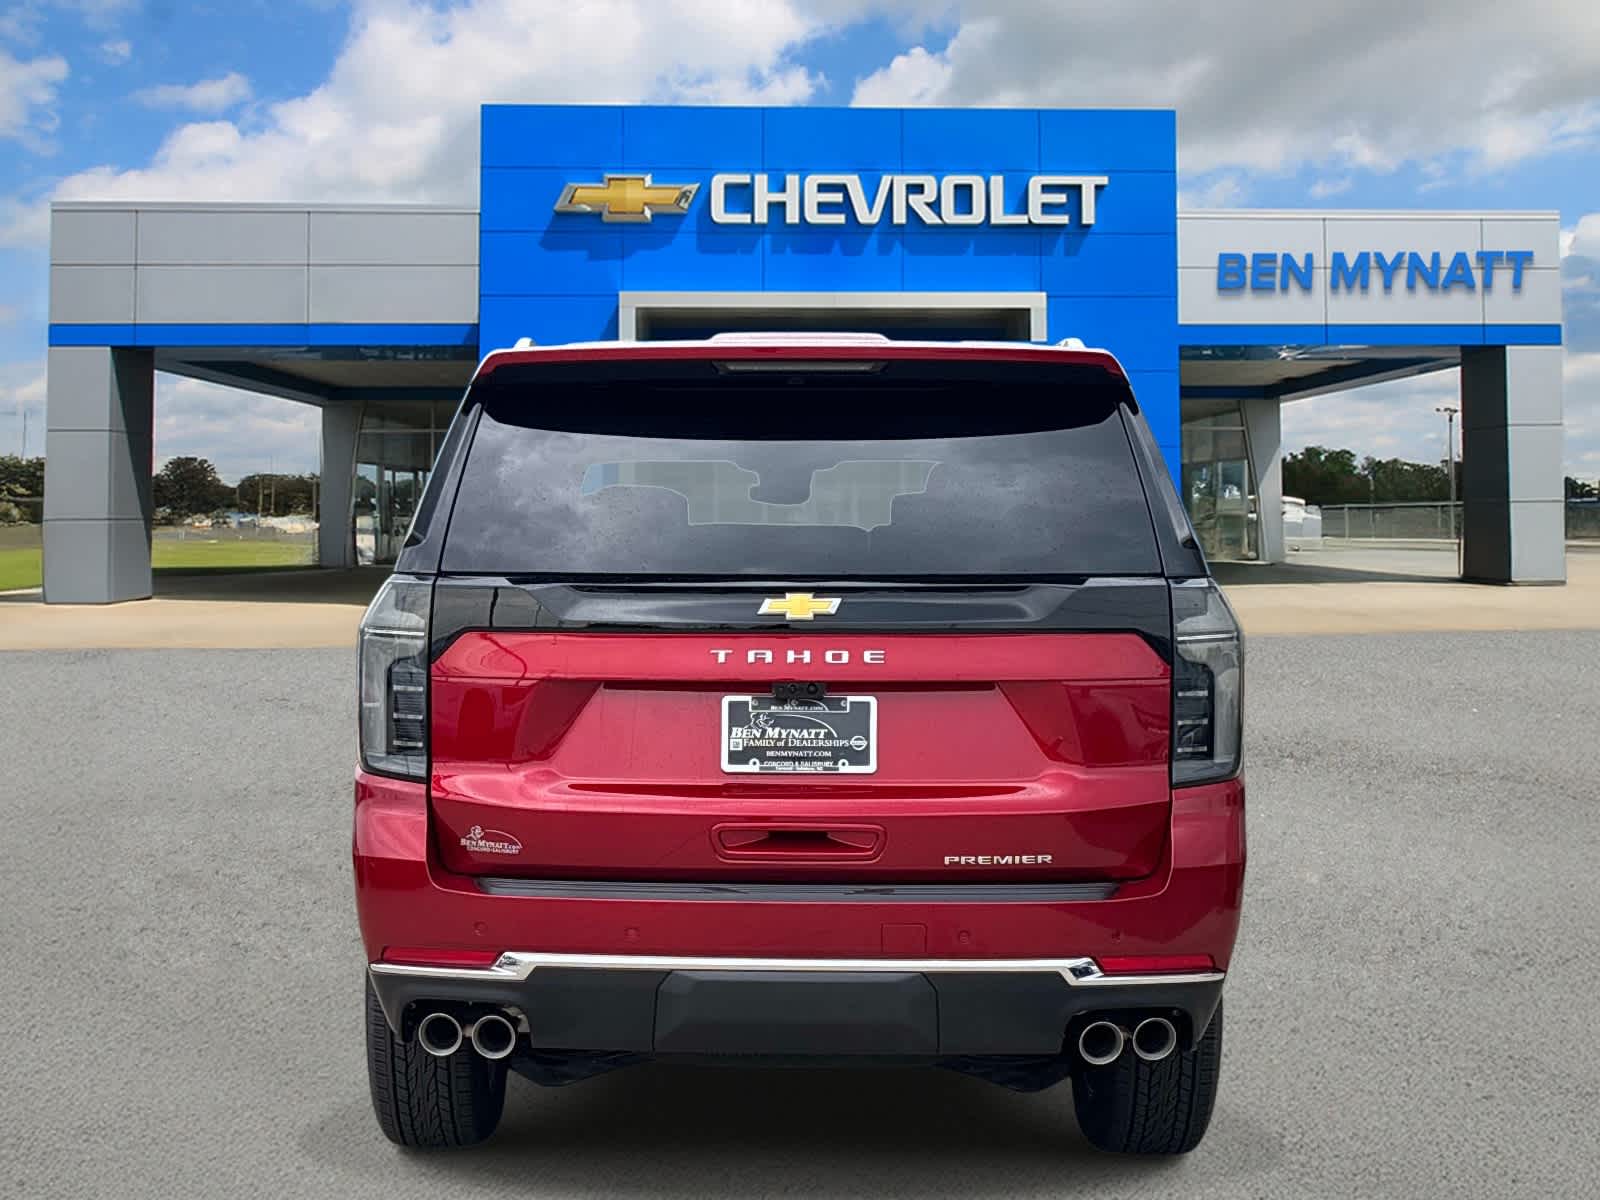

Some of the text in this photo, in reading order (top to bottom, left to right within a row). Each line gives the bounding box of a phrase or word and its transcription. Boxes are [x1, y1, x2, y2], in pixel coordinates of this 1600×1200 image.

[710, 173, 1109, 226] CHEVROLET
[1217, 250, 1534, 290] BEN MYNATT
[709, 649, 886, 664] TAHOE
[730, 727, 828, 739] BEN MYNATT
[743, 738, 776, 747] FAMILY
[777, 738, 785, 747] of
[788, 738, 849, 747] DEALERSHIPS
[944, 855, 1053, 865] PREMIER
